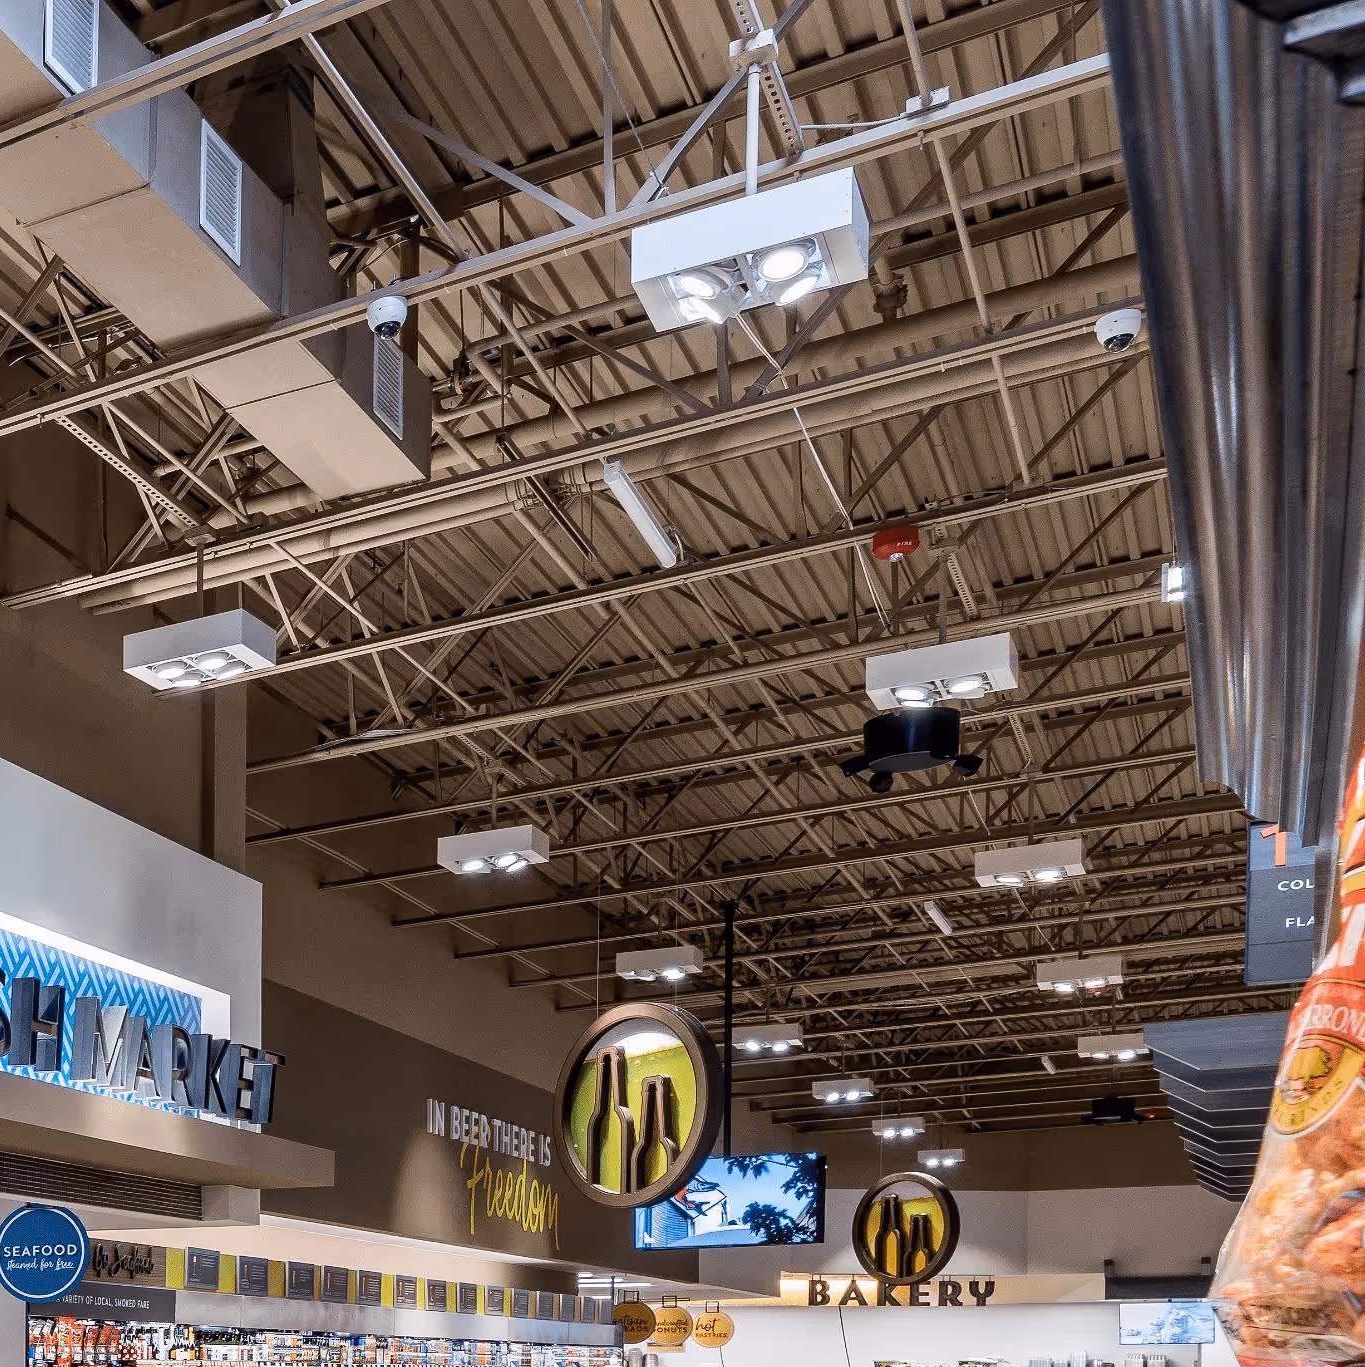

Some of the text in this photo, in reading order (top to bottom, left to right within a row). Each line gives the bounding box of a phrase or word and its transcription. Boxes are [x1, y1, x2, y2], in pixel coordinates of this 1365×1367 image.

[72, 997, 286, 1125] MARKET
[426, 1098, 551, 1167] IN BEER THERE IS
[460, 1138, 560, 1250] Freedom
[3, 1244, 78, 1258] SEAFOOD
[6, 1257, 75, 1271] steamed for free
[61, 1294, 150, 1309] VARIETY OF LOCAL, SMOKED FARE
[808, 1279, 996, 1307] BAKERY
[695, 1317, 720, 1333] hot
